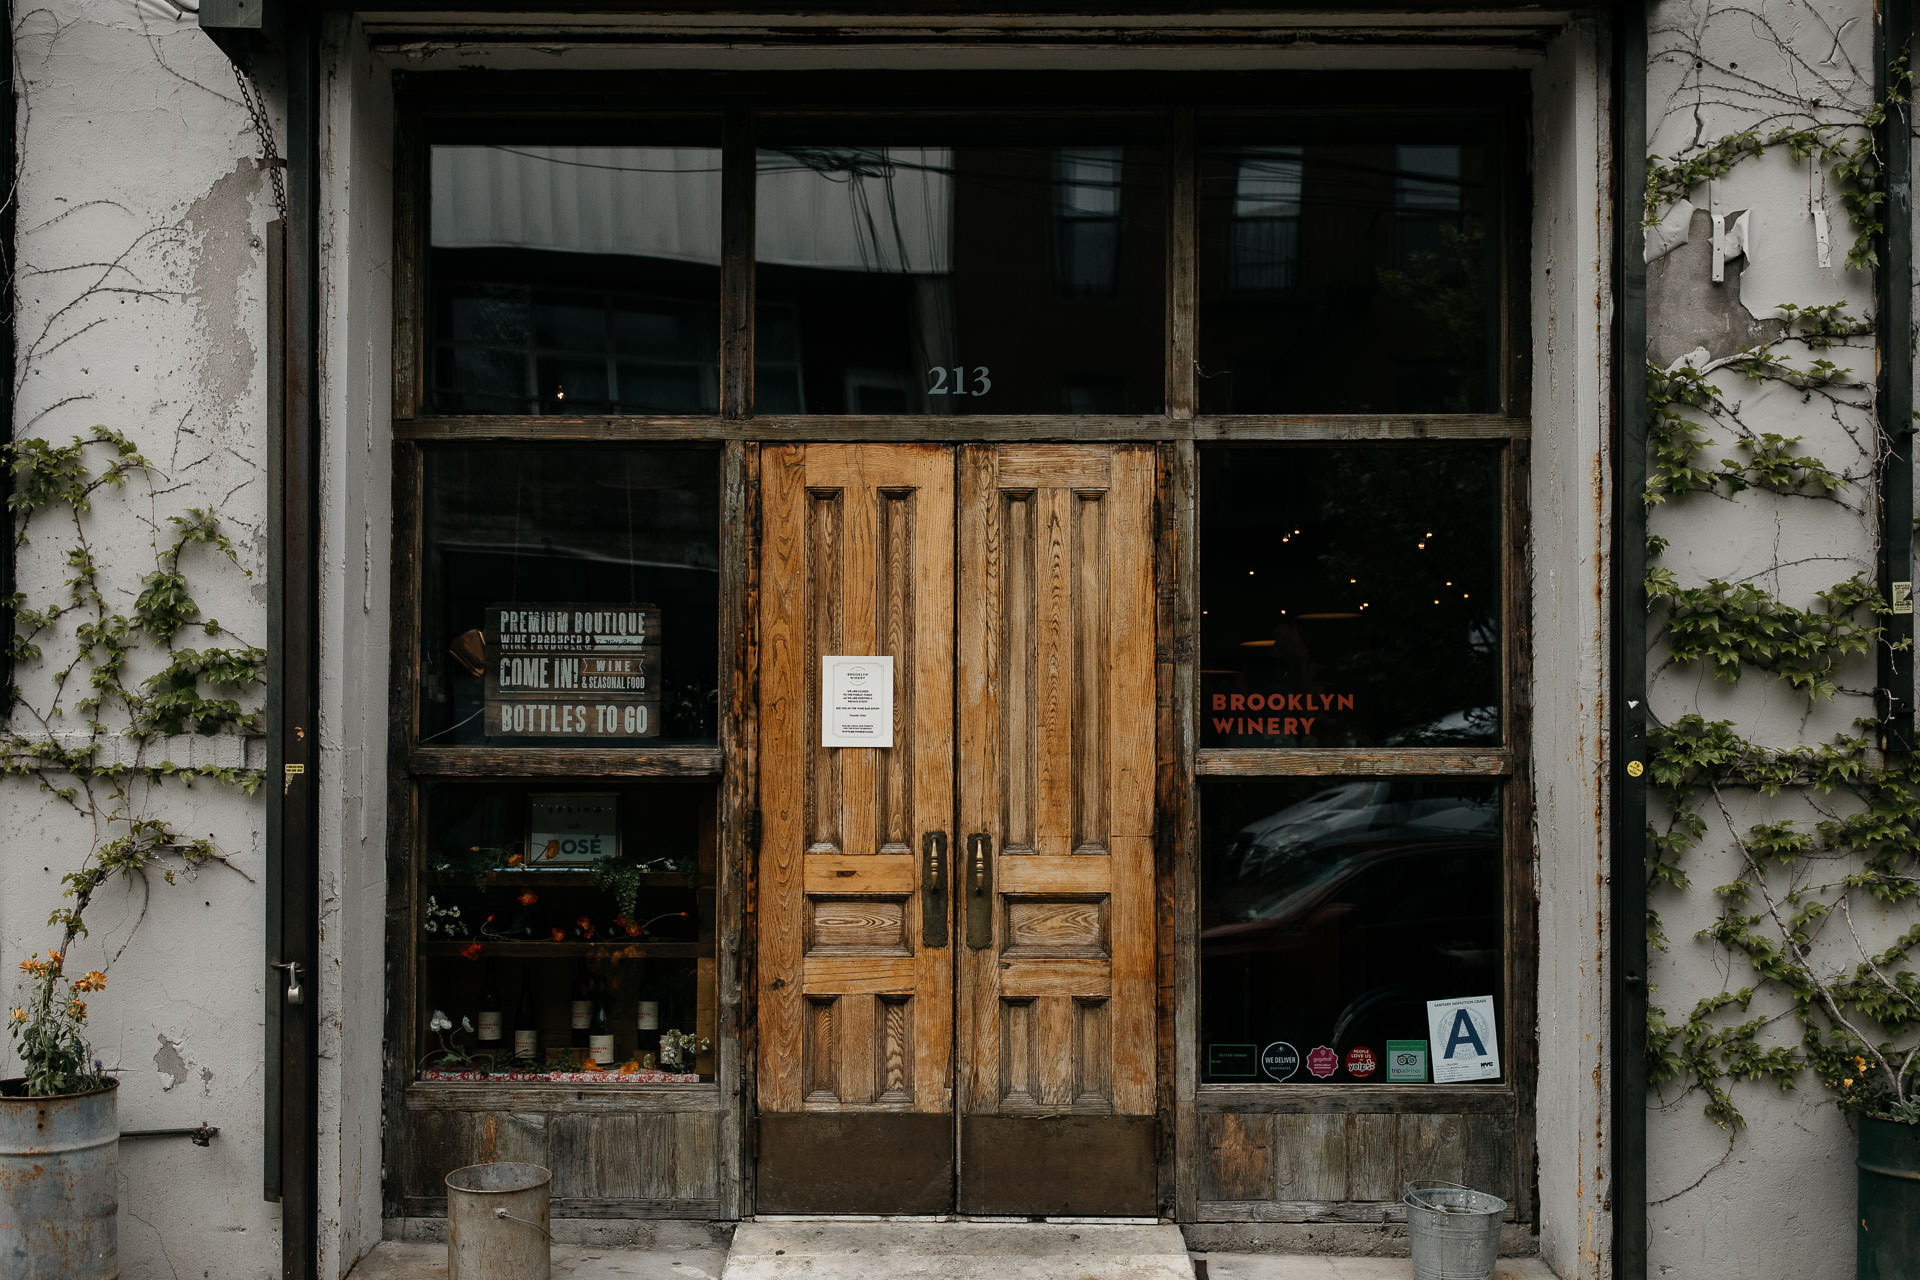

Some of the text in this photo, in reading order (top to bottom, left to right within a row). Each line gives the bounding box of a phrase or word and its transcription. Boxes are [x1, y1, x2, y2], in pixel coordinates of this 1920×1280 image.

[927, 366, 992, 397] 213
[500, 610, 646, 636] PREMIUM BOUTIQUE
[500, 634, 526, 650] WINE
[530, 634, 583, 650] PRODUCER
[500, 657, 579, 689] COME IN!
[596, 660, 631, 672] WINE
[581, 676, 645, 689] & SEASONAL FOOD
[1212, 693, 1354, 711] BROOKLYN
[501, 704, 648, 734] BOTTLES TO GO
[1212, 717, 1316, 735] WINERY
[547, 834, 602, 854] OSÉ
[1443, 1009, 1488, 1059] A
[1265, 1056, 1296, 1064] WE DELIVER
[1349, 1062, 1367, 1072] yelp
